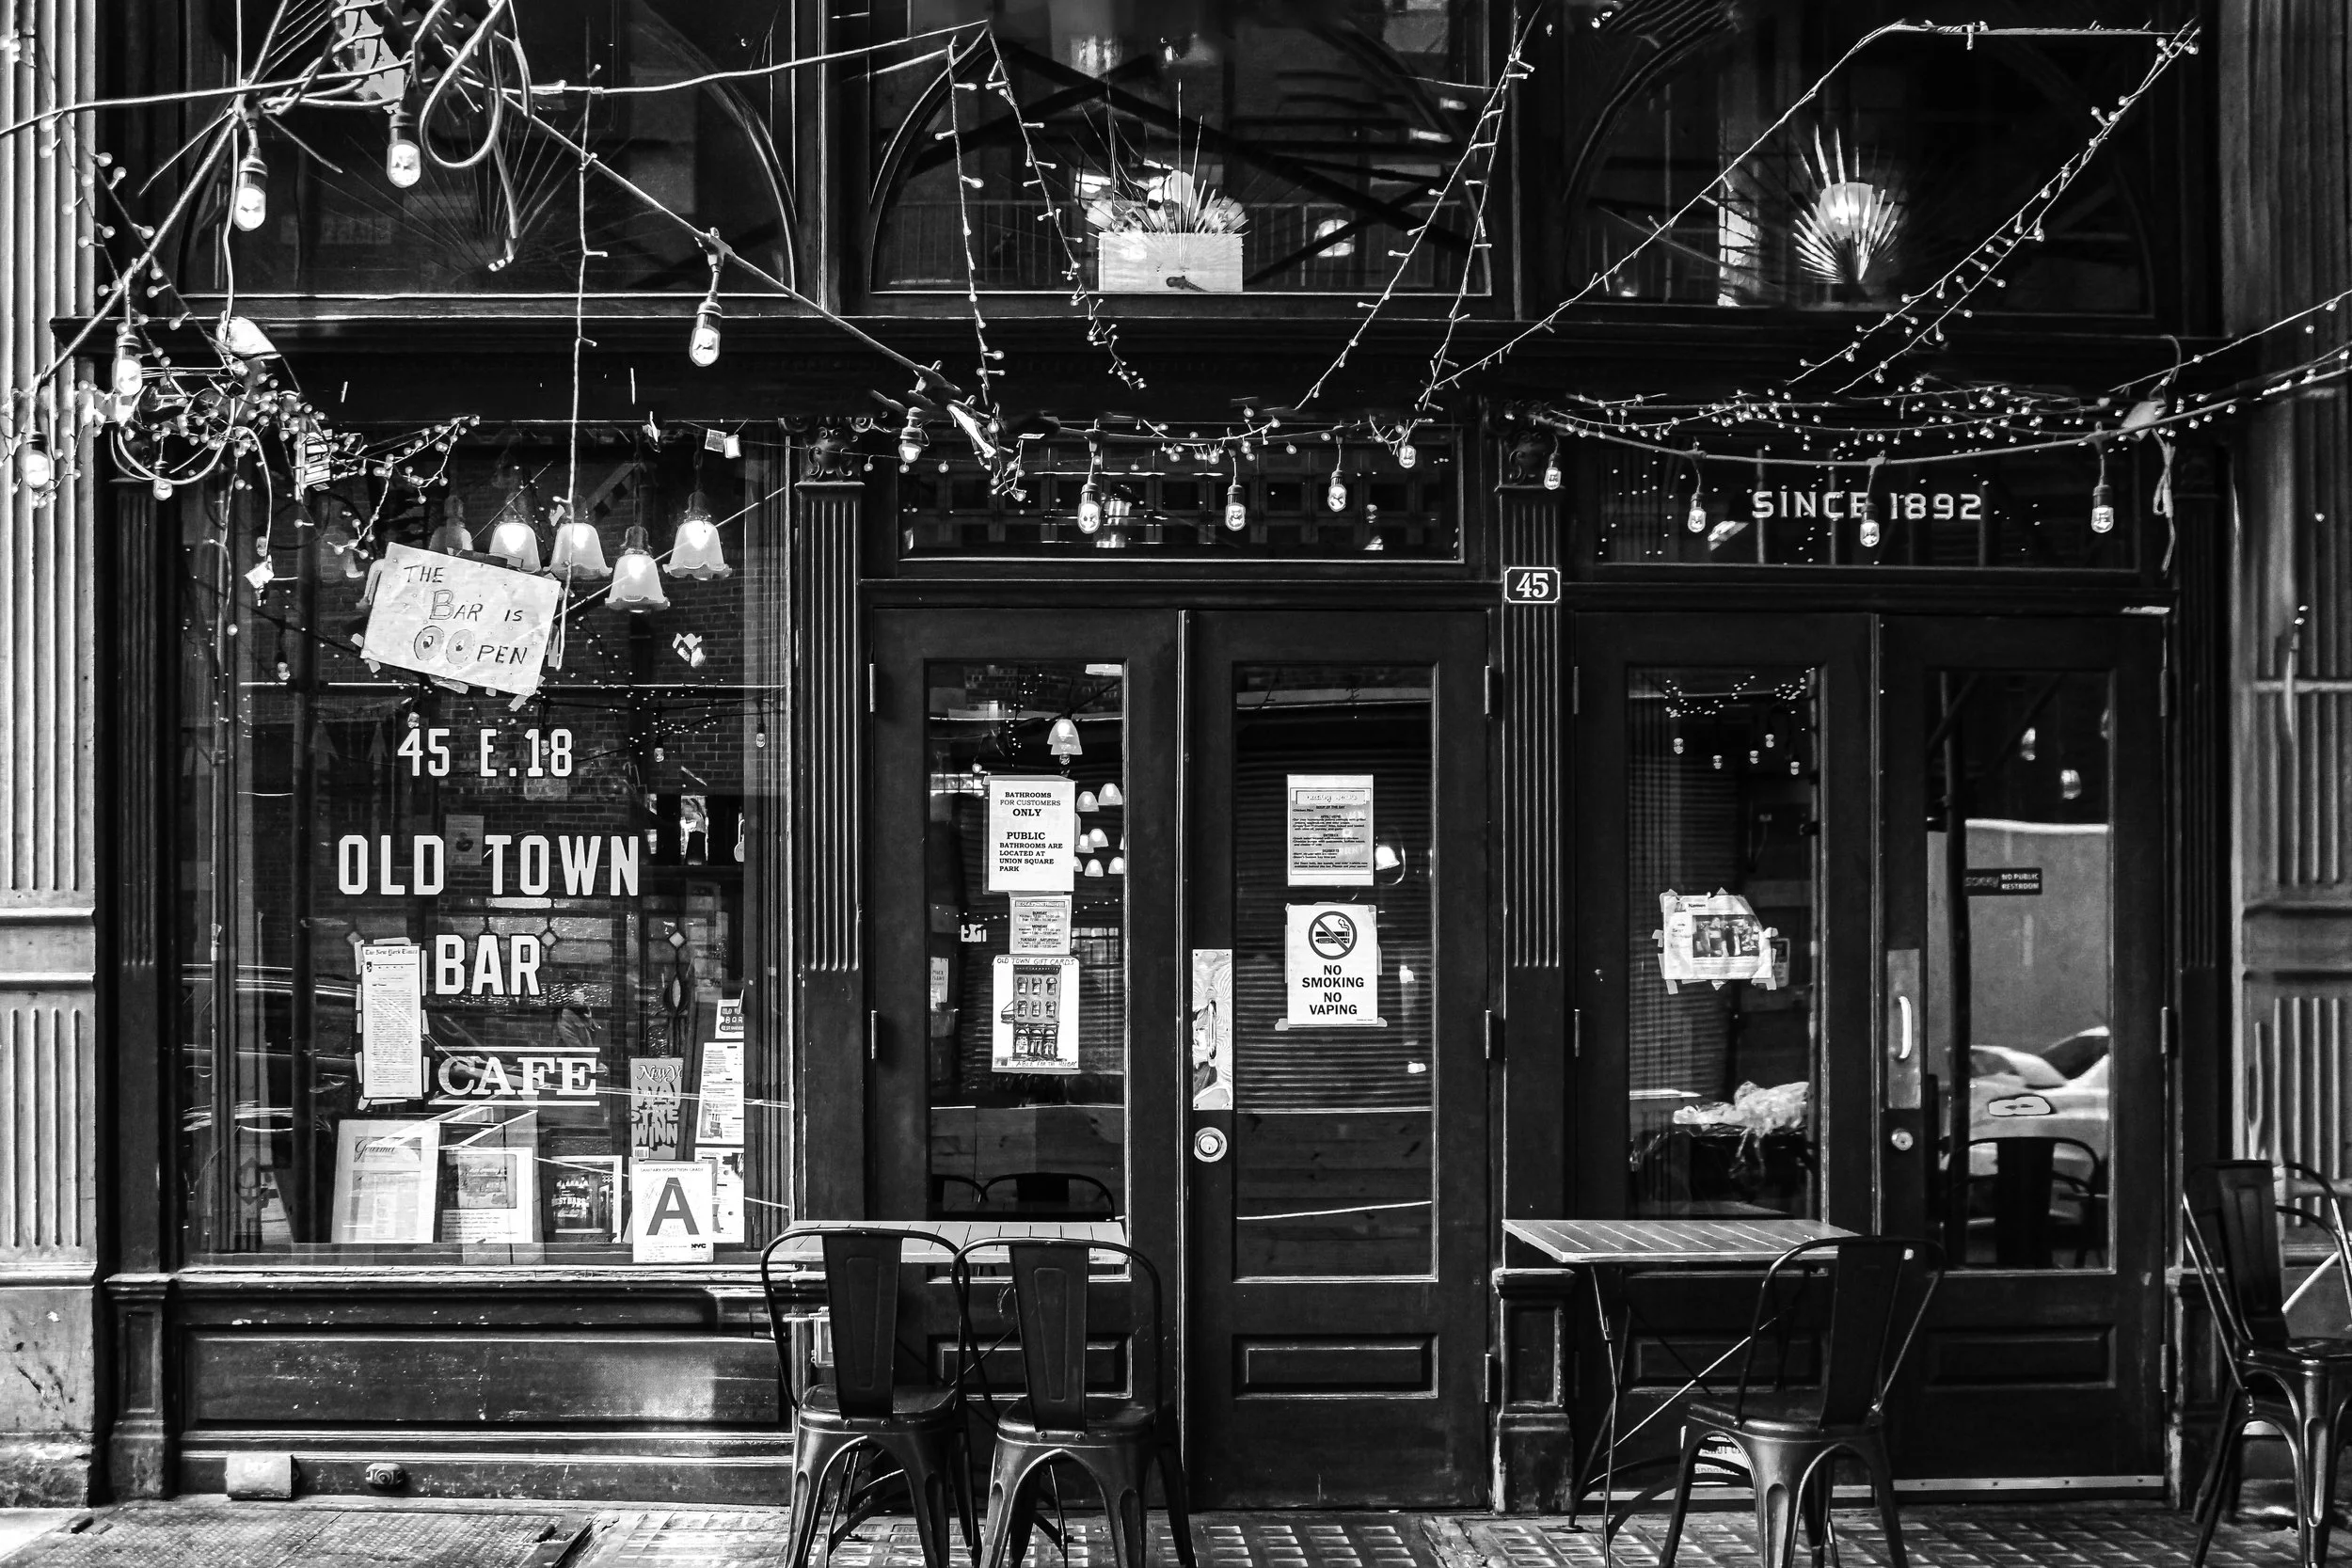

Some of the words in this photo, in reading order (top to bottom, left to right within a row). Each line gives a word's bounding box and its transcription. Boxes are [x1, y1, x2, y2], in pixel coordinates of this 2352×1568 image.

[1752, 491, 1869, 518] SINCE
[1890, 492, 1981, 520] 1892
[404, 565, 444, 583] THE
[1516, 572, 1549, 598] 45
[397, 728, 451, 777] 45
[1012, 808, 1041, 816] ONLY
[1007, 832, 1046, 840] PUBLIC
[338, 834, 444, 895] OLD
[485, 834, 639, 896] TOWN
[436, 934, 541, 996] BAR
[1323, 964, 1343, 975] NO
[1301, 976, 1364, 989] SMOKING
[1324, 991, 1343, 1003] NO
[1309, 1004, 1358, 1015] VAPING
[725, 1016, 743, 1024] BAR
[437, 1055, 597, 1096] CAFE
[645, 1177, 701, 1236] A
